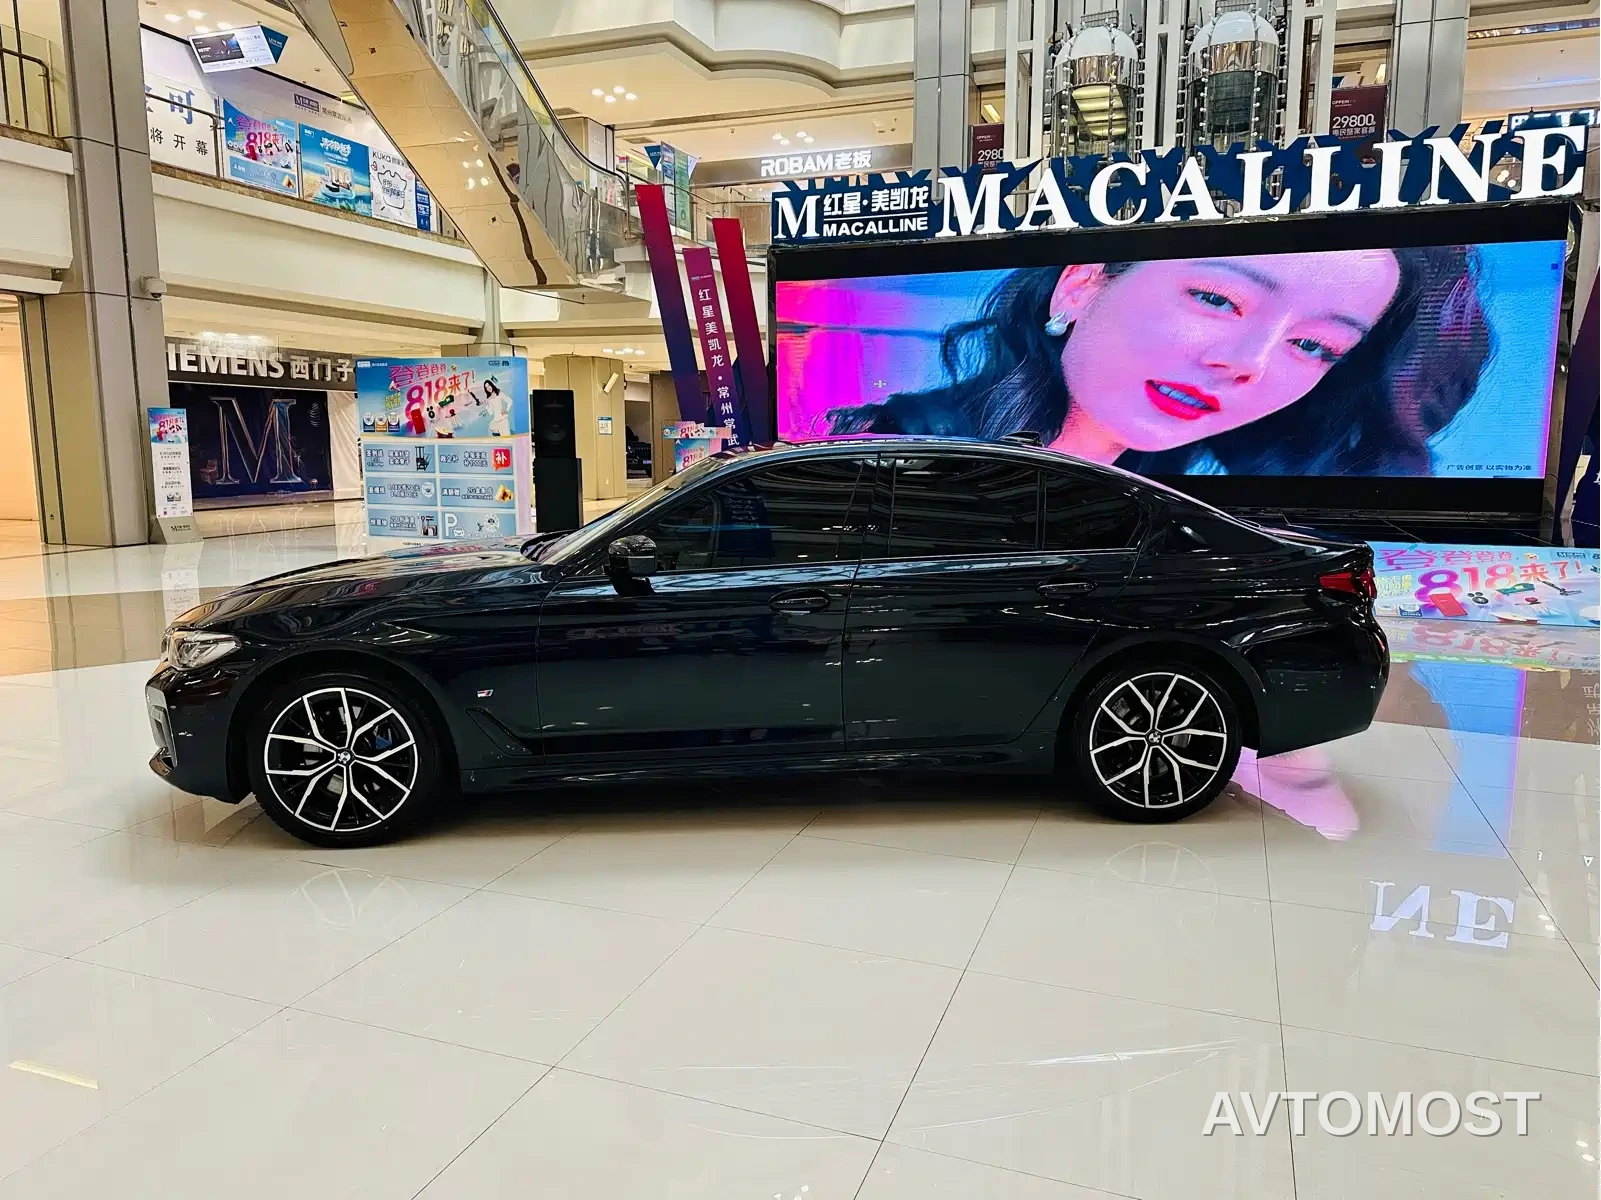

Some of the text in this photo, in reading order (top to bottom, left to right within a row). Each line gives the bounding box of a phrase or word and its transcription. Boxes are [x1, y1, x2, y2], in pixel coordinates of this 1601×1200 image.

[934, 125, 1587, 237] MACALLINE
[823, 217, 928, 237] MACALLINE
[290, 355, 353, 382] 西门子
[209, 396, 302, 485] M
[495, 451, 508, 465] 补
